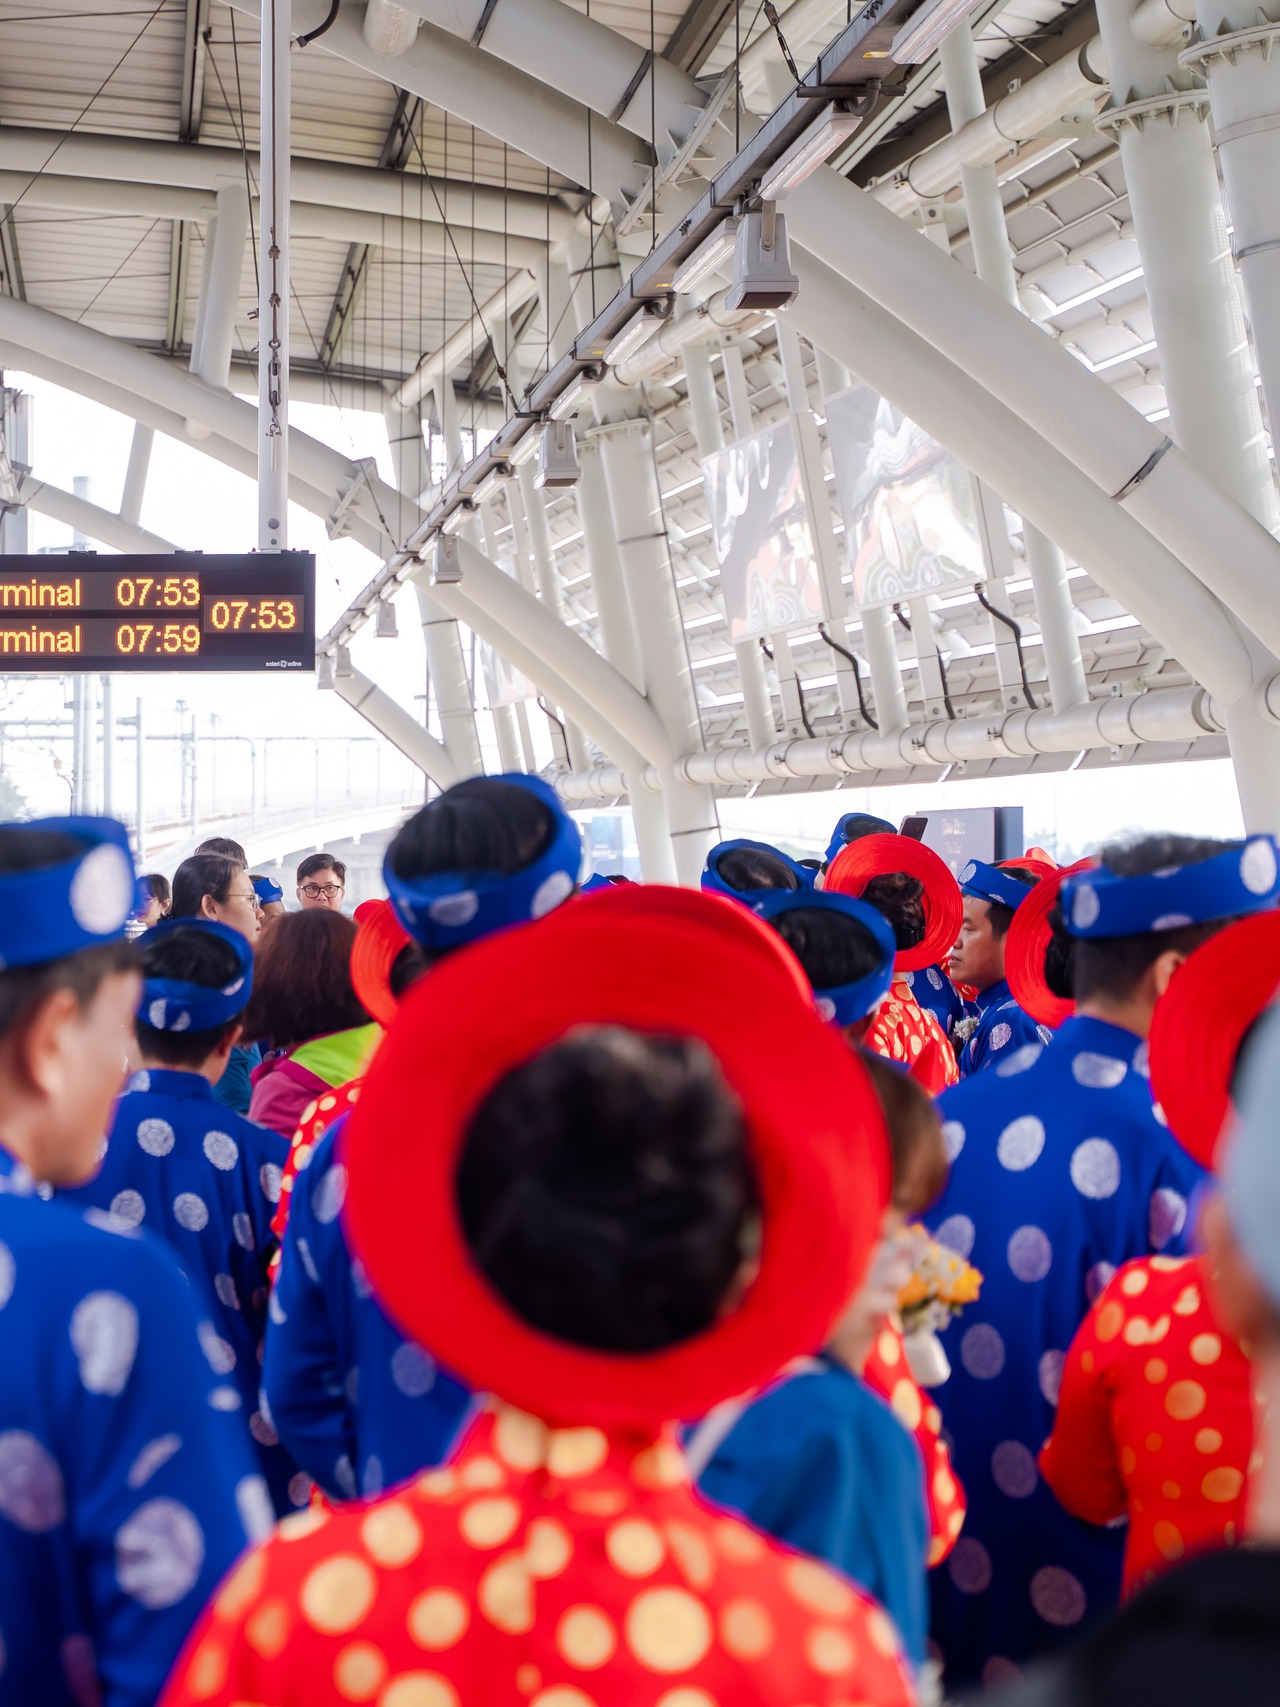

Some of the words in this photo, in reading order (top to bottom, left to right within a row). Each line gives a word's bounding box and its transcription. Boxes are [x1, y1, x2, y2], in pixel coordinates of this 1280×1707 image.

[117, 578, 201, 607] 07:53
[212, 601, 297, 630] 07:53
[116, 624, 201, 653] 07:59
